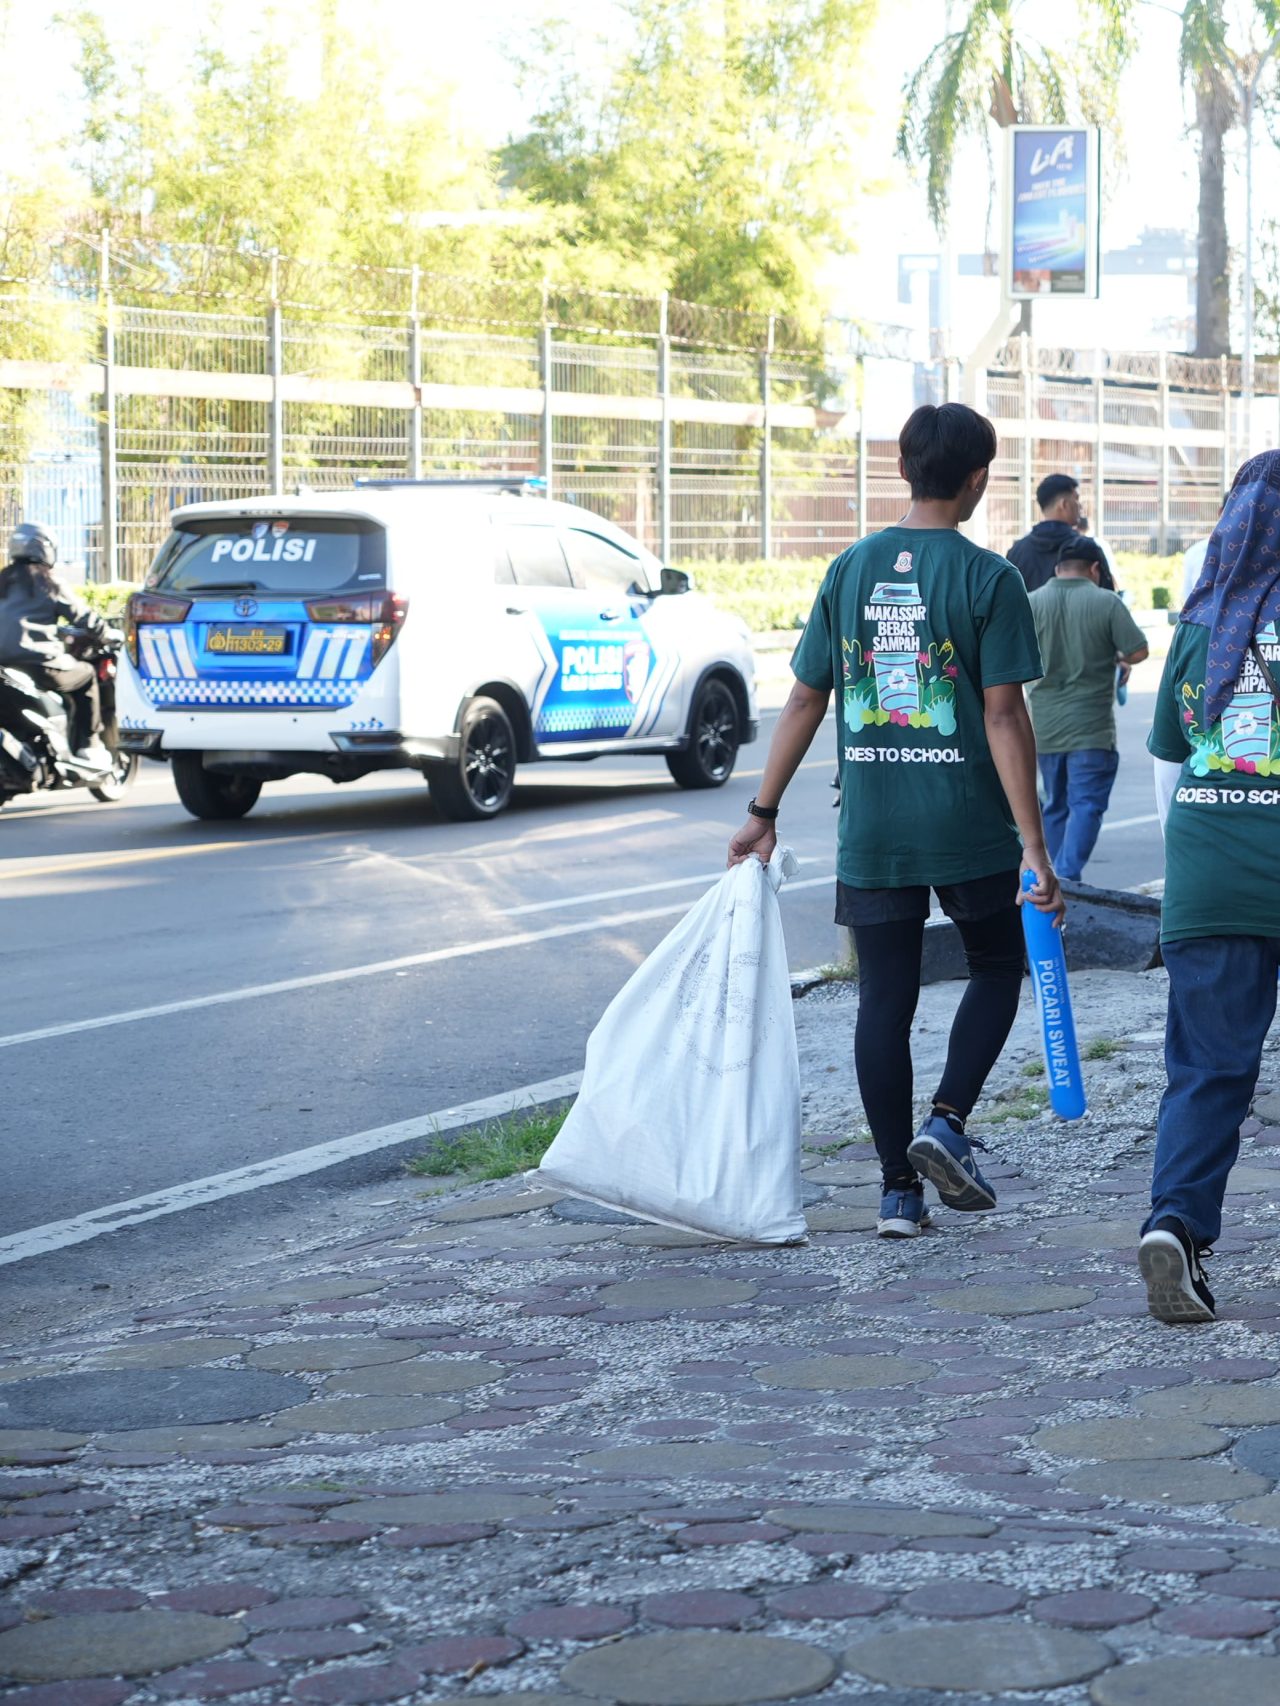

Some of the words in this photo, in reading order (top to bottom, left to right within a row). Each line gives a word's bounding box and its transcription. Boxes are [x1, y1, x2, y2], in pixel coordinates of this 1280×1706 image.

[1030, 135, 1075, 176] LA
[211, 539, 317, 563] POLISI
[864, 605, 927, 621] MAKASSAR
[877, 621, 915, 636] BEBAS
[872, 636, 920, 652] SAMPAH
[877, 747, 899, 762] TO
[900, 747, 965, 763] SCHOOL
[1176, 787, 1218, 804] GOES
[1219, 789, 1245, 804] TO
[1038, 959, 1063, 1026] POCARI
[1048, 1029, 1072, 1088] SWEAT
